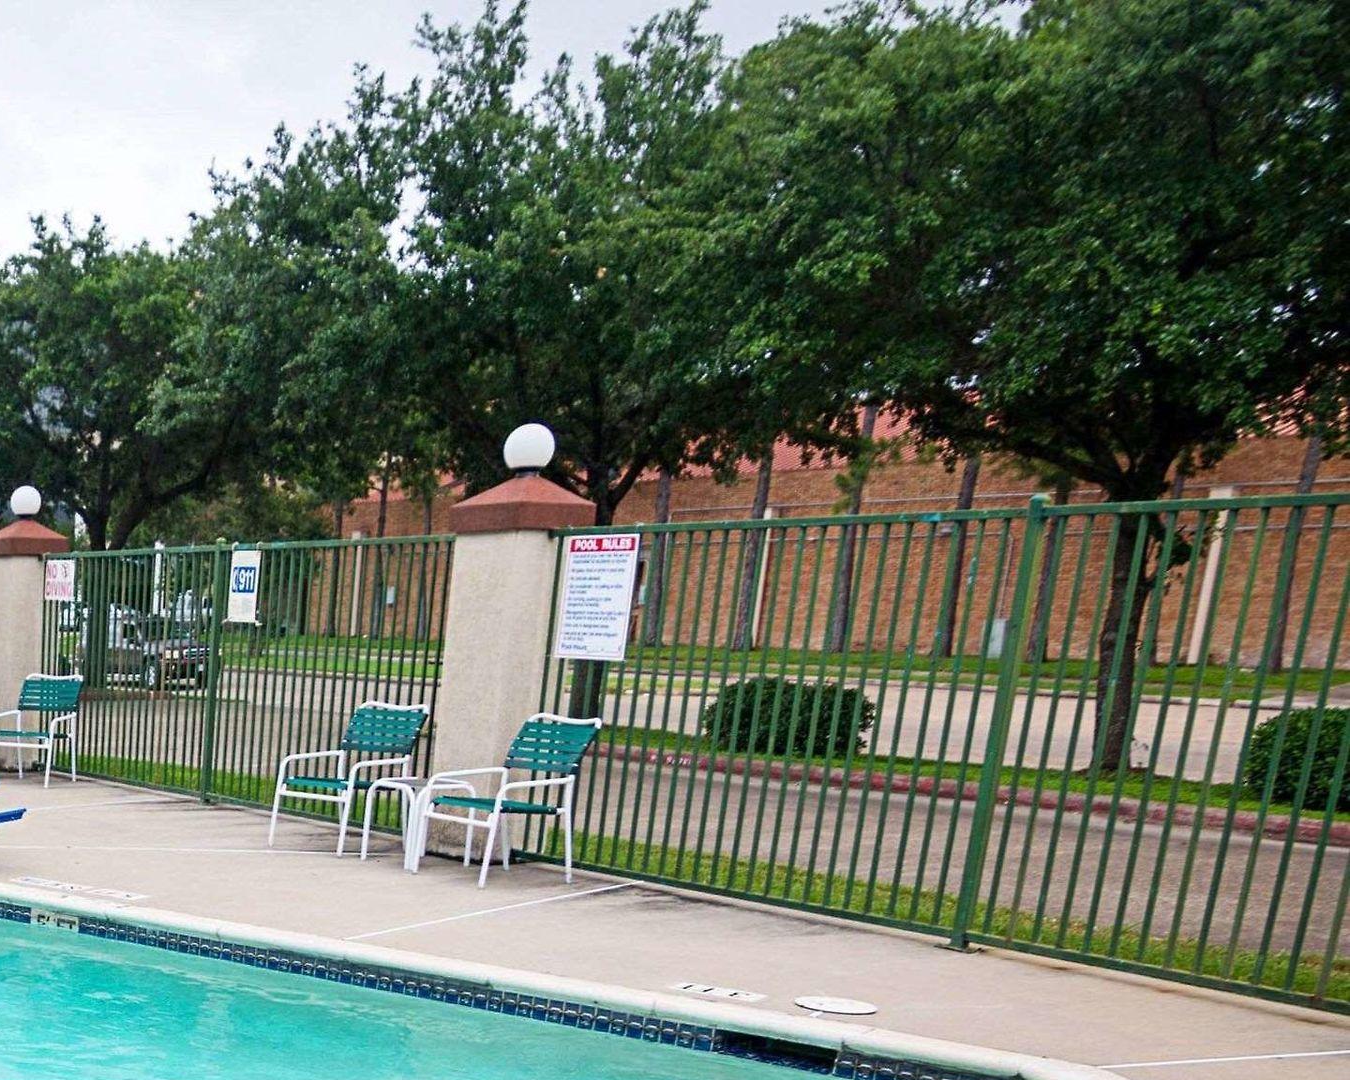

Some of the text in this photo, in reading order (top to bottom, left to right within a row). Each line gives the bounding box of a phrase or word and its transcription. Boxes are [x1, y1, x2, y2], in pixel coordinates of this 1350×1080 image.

[575, 538, 632, 551] POOL RULES
[47, 563, 58, 579] NO
[239, 568, 255, 592] 911
